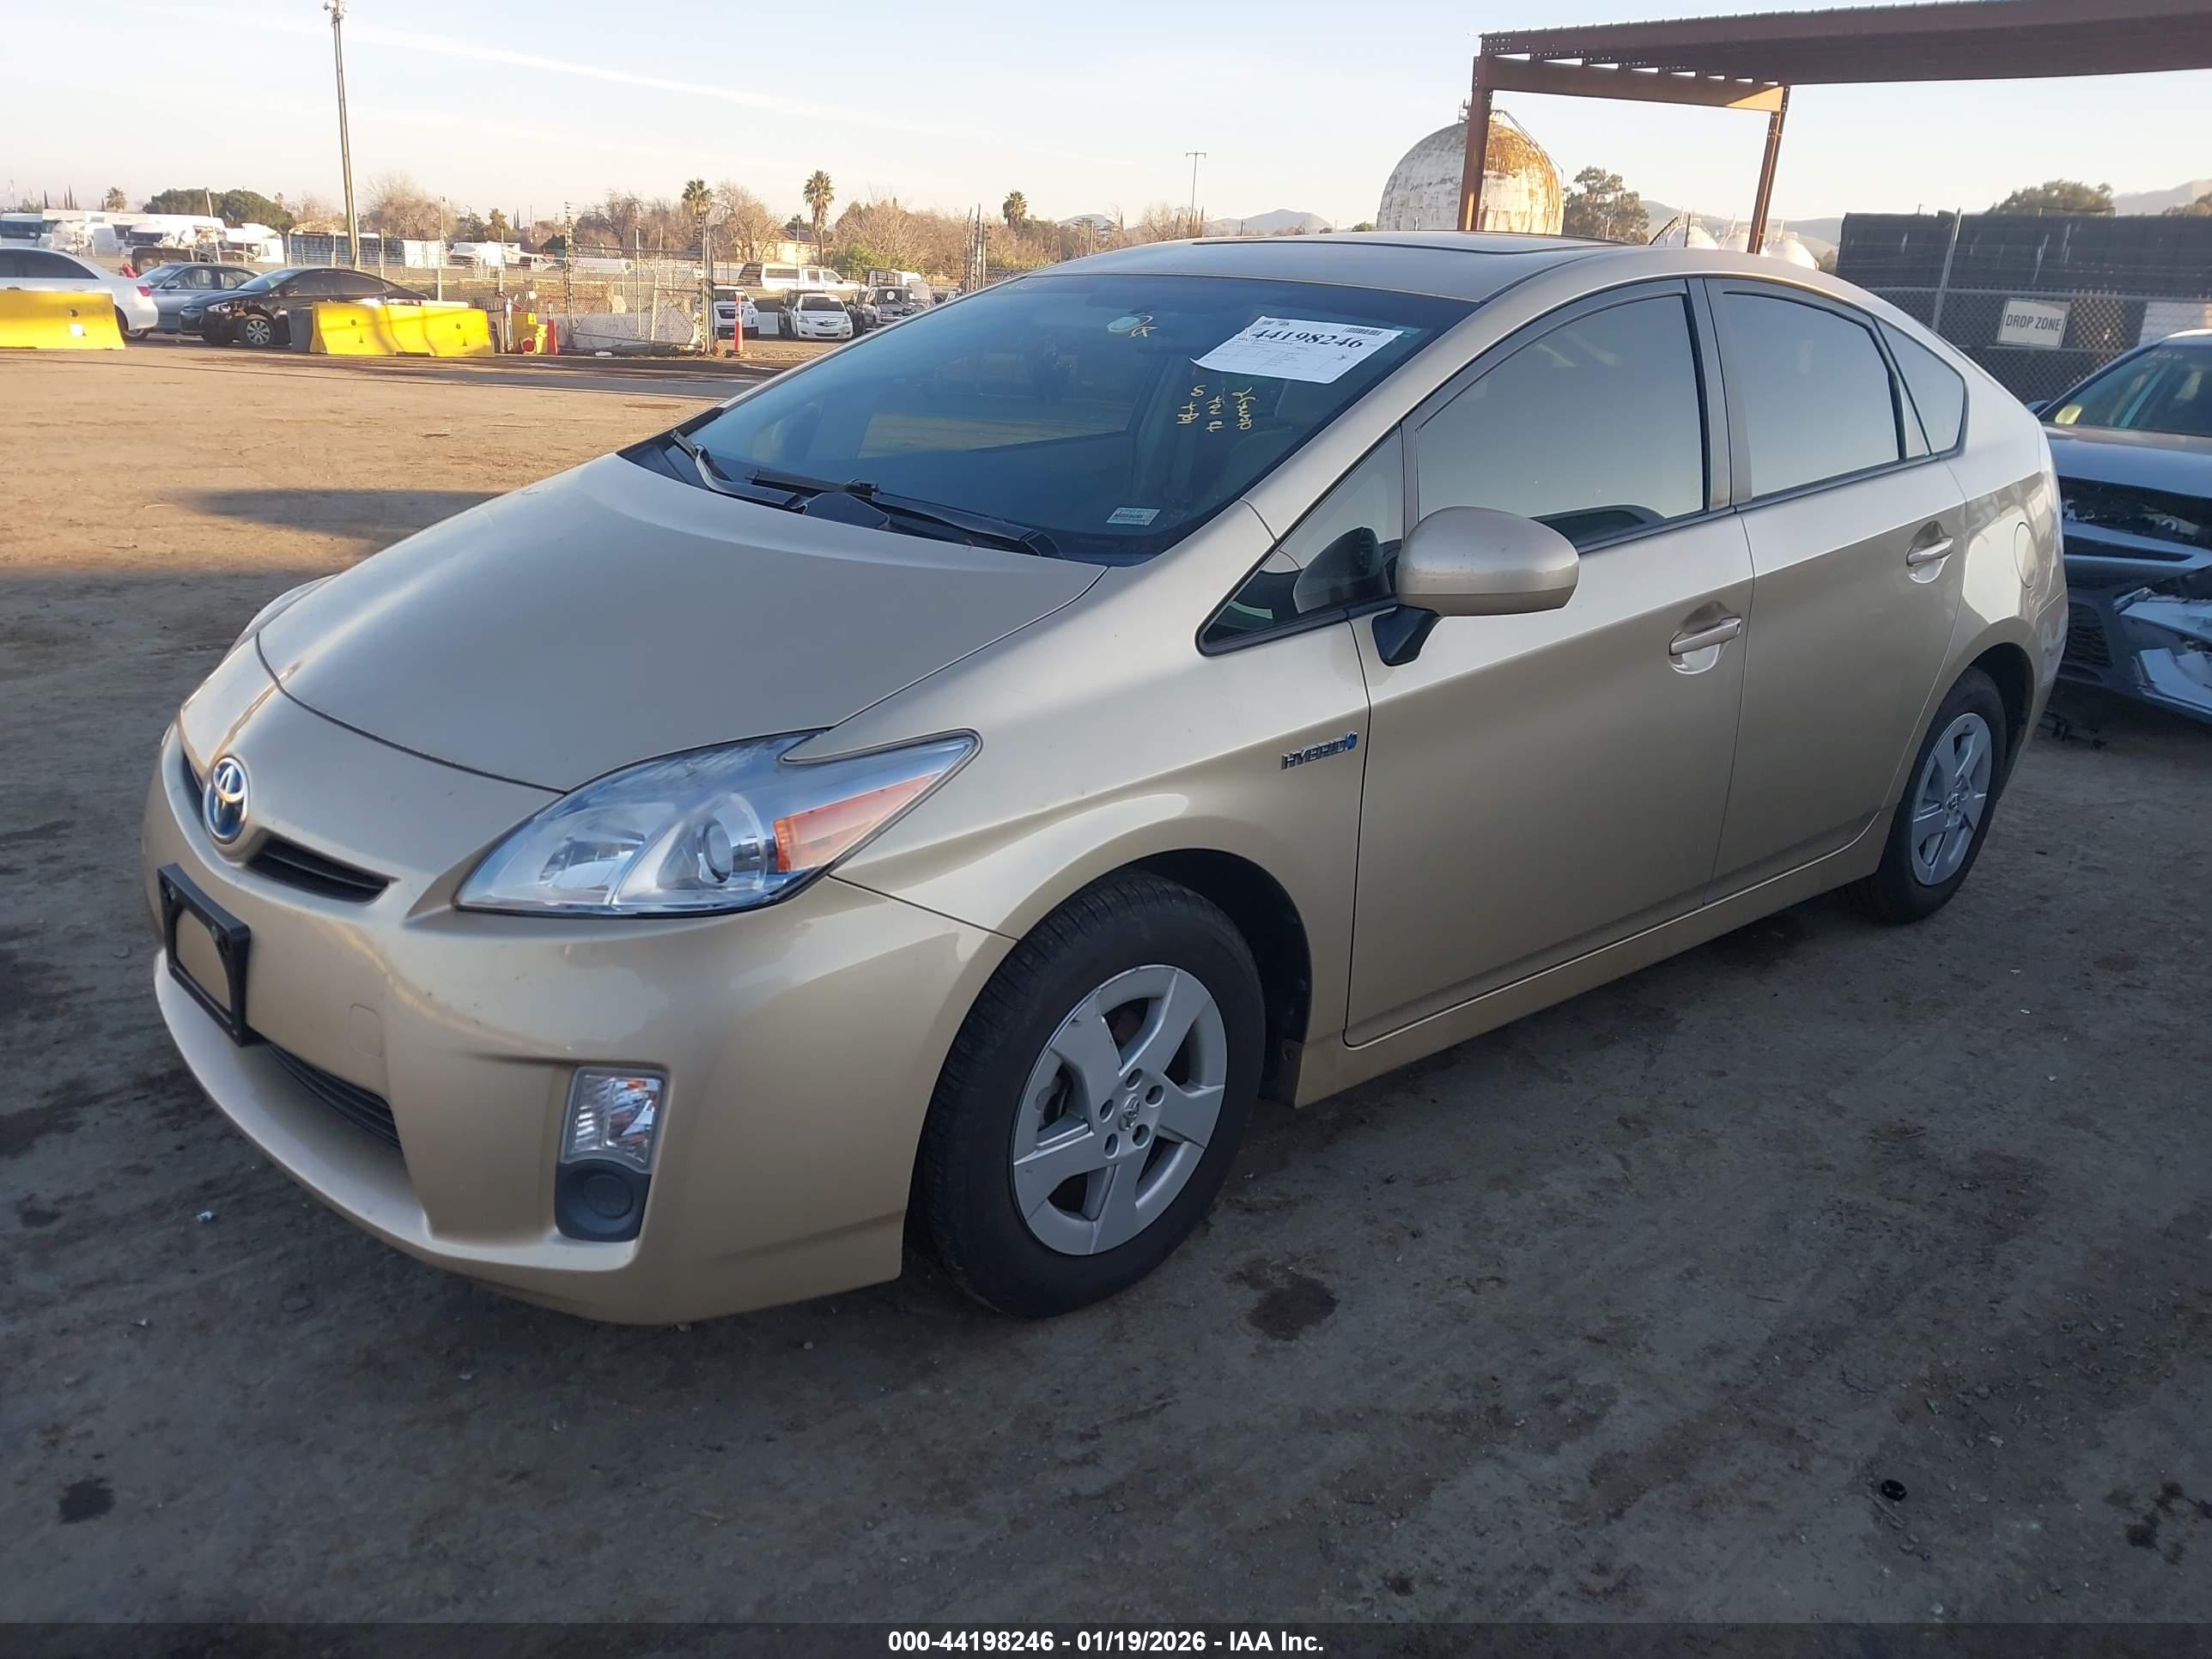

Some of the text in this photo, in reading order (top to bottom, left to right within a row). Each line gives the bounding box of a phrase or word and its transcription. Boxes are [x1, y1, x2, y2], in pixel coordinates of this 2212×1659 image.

[2006, 315, 2062, 331] DROP ZONE
[1250, 328, 1367, 349] 44198246
[1279, 737, 1347, 770] HYBRID
